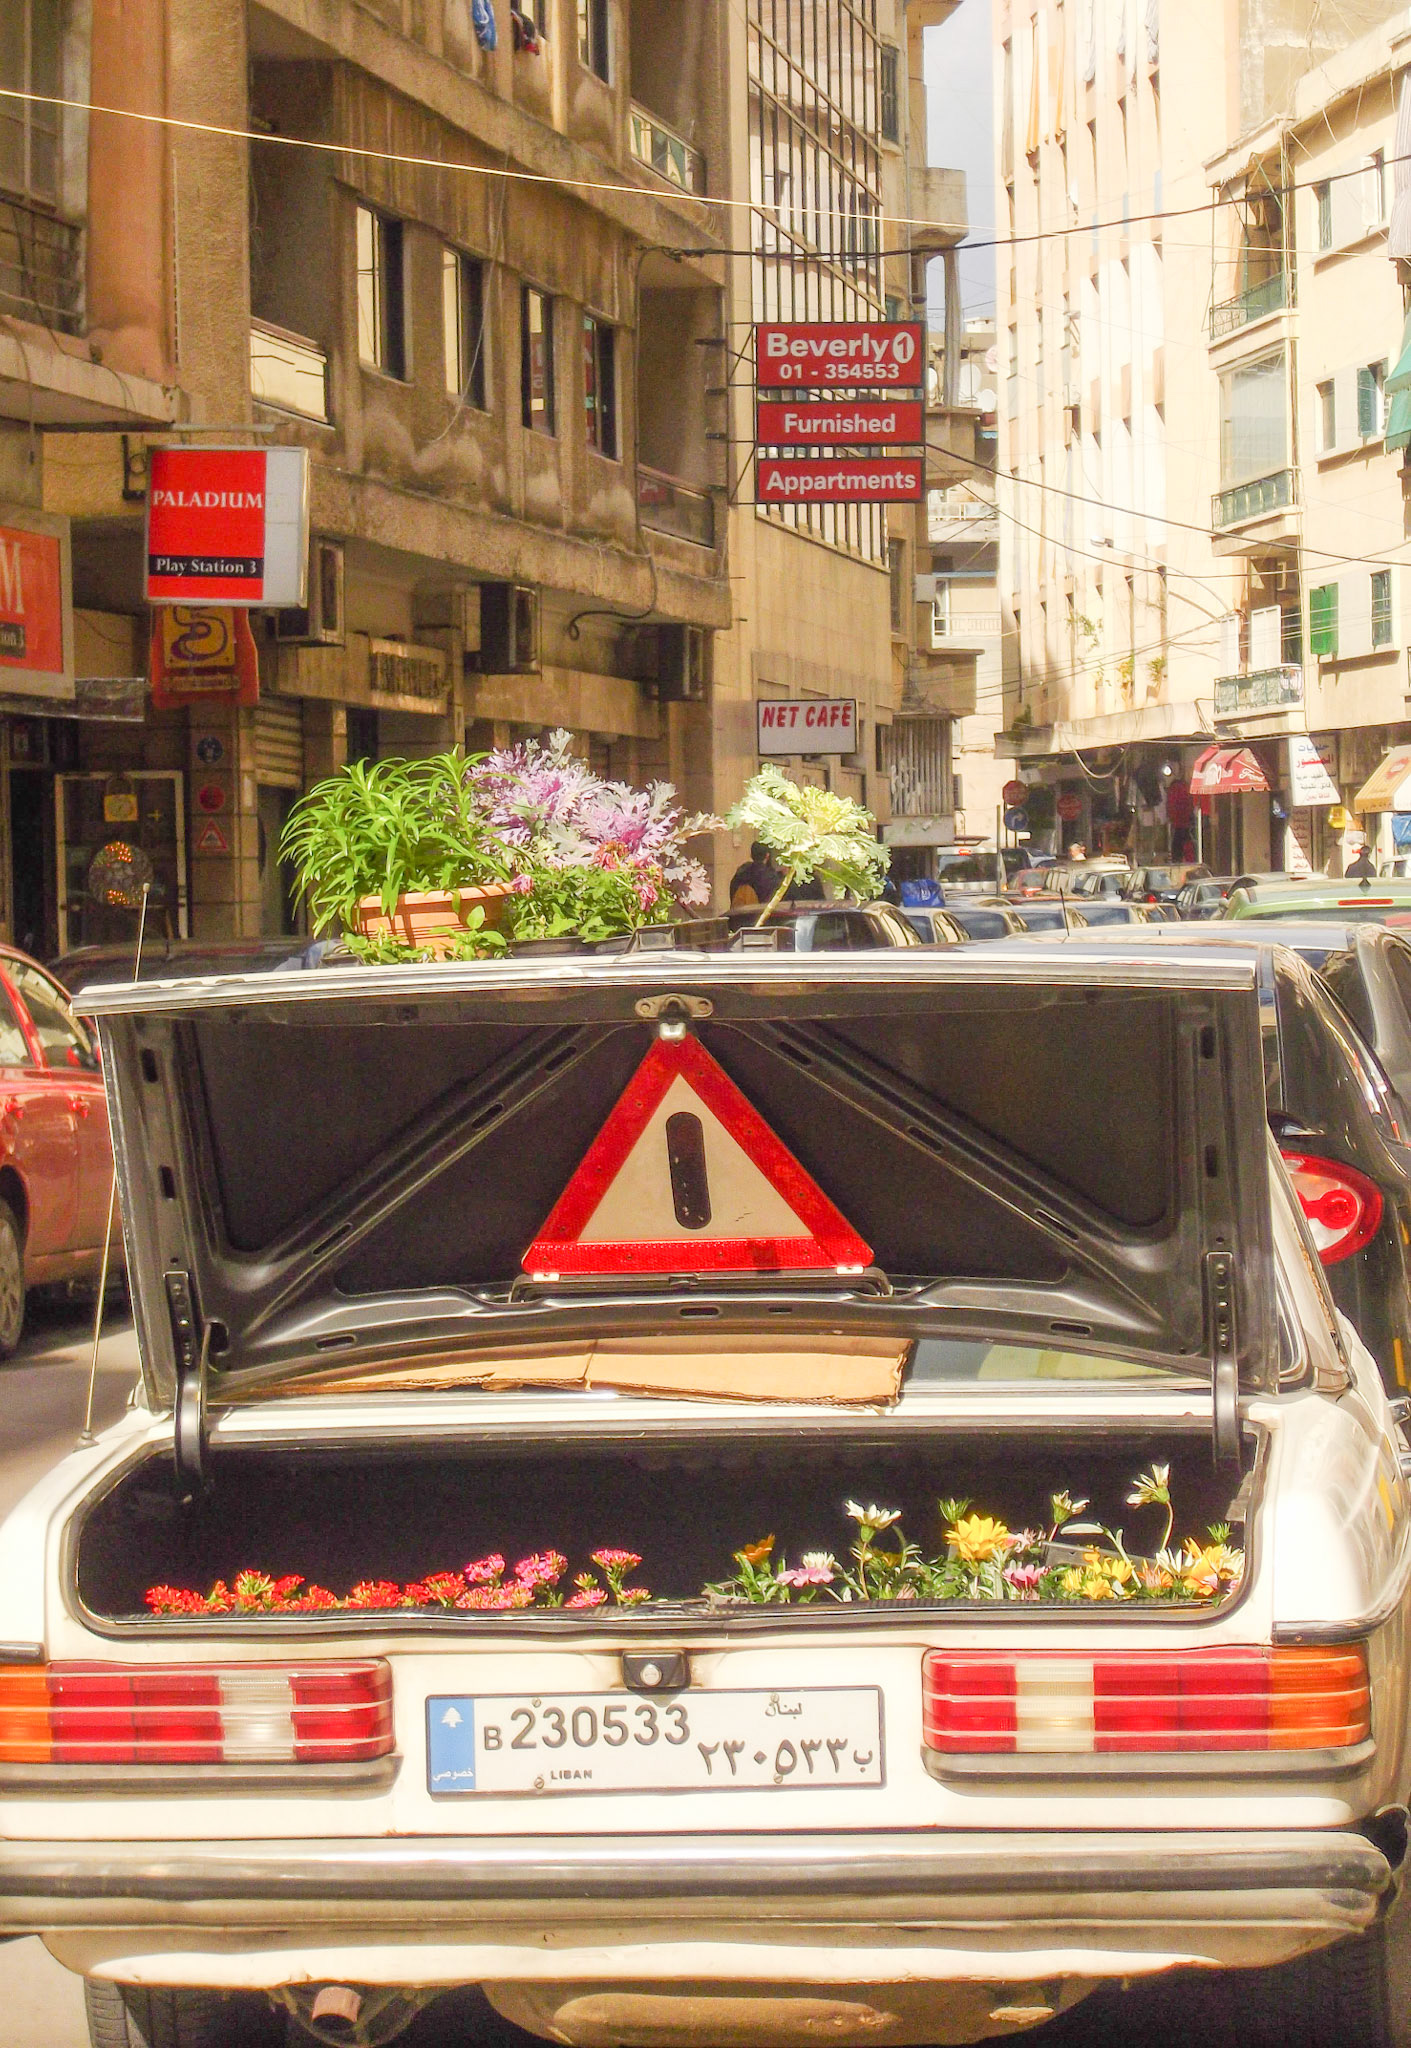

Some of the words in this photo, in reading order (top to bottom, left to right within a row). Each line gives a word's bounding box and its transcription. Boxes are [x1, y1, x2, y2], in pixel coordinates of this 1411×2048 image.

[767, 332, 889, 362] Beverly
[780, 363, 802, 379] 01
[825, 363, 899, 379] 354553
[784, 413, 896, 433] Furnished
[766, 470, 916, 495] Appartments
[153, 490, 264, 509] PALADIUM
[156, 558, 187, 576] Play
[191, 558, 245, 574] Station
[250, 560, 257, 574] 3
[762, 704, 800, 728] NET
[805, 702, 853, 728] CAFÉ
[765, 1702, 803, 1719] لبنان
[483, 1725, 503, 1751] B
[511, 1703, 691, 1750] 230533
[697, 1738, 849, 1776] ٢٣٠٥٣٣
[853, 1749, 873, 1773] ب
[432, 1767, 474, 1783] خصوصي
[550, 1769, 593, 1781] LIBAN
